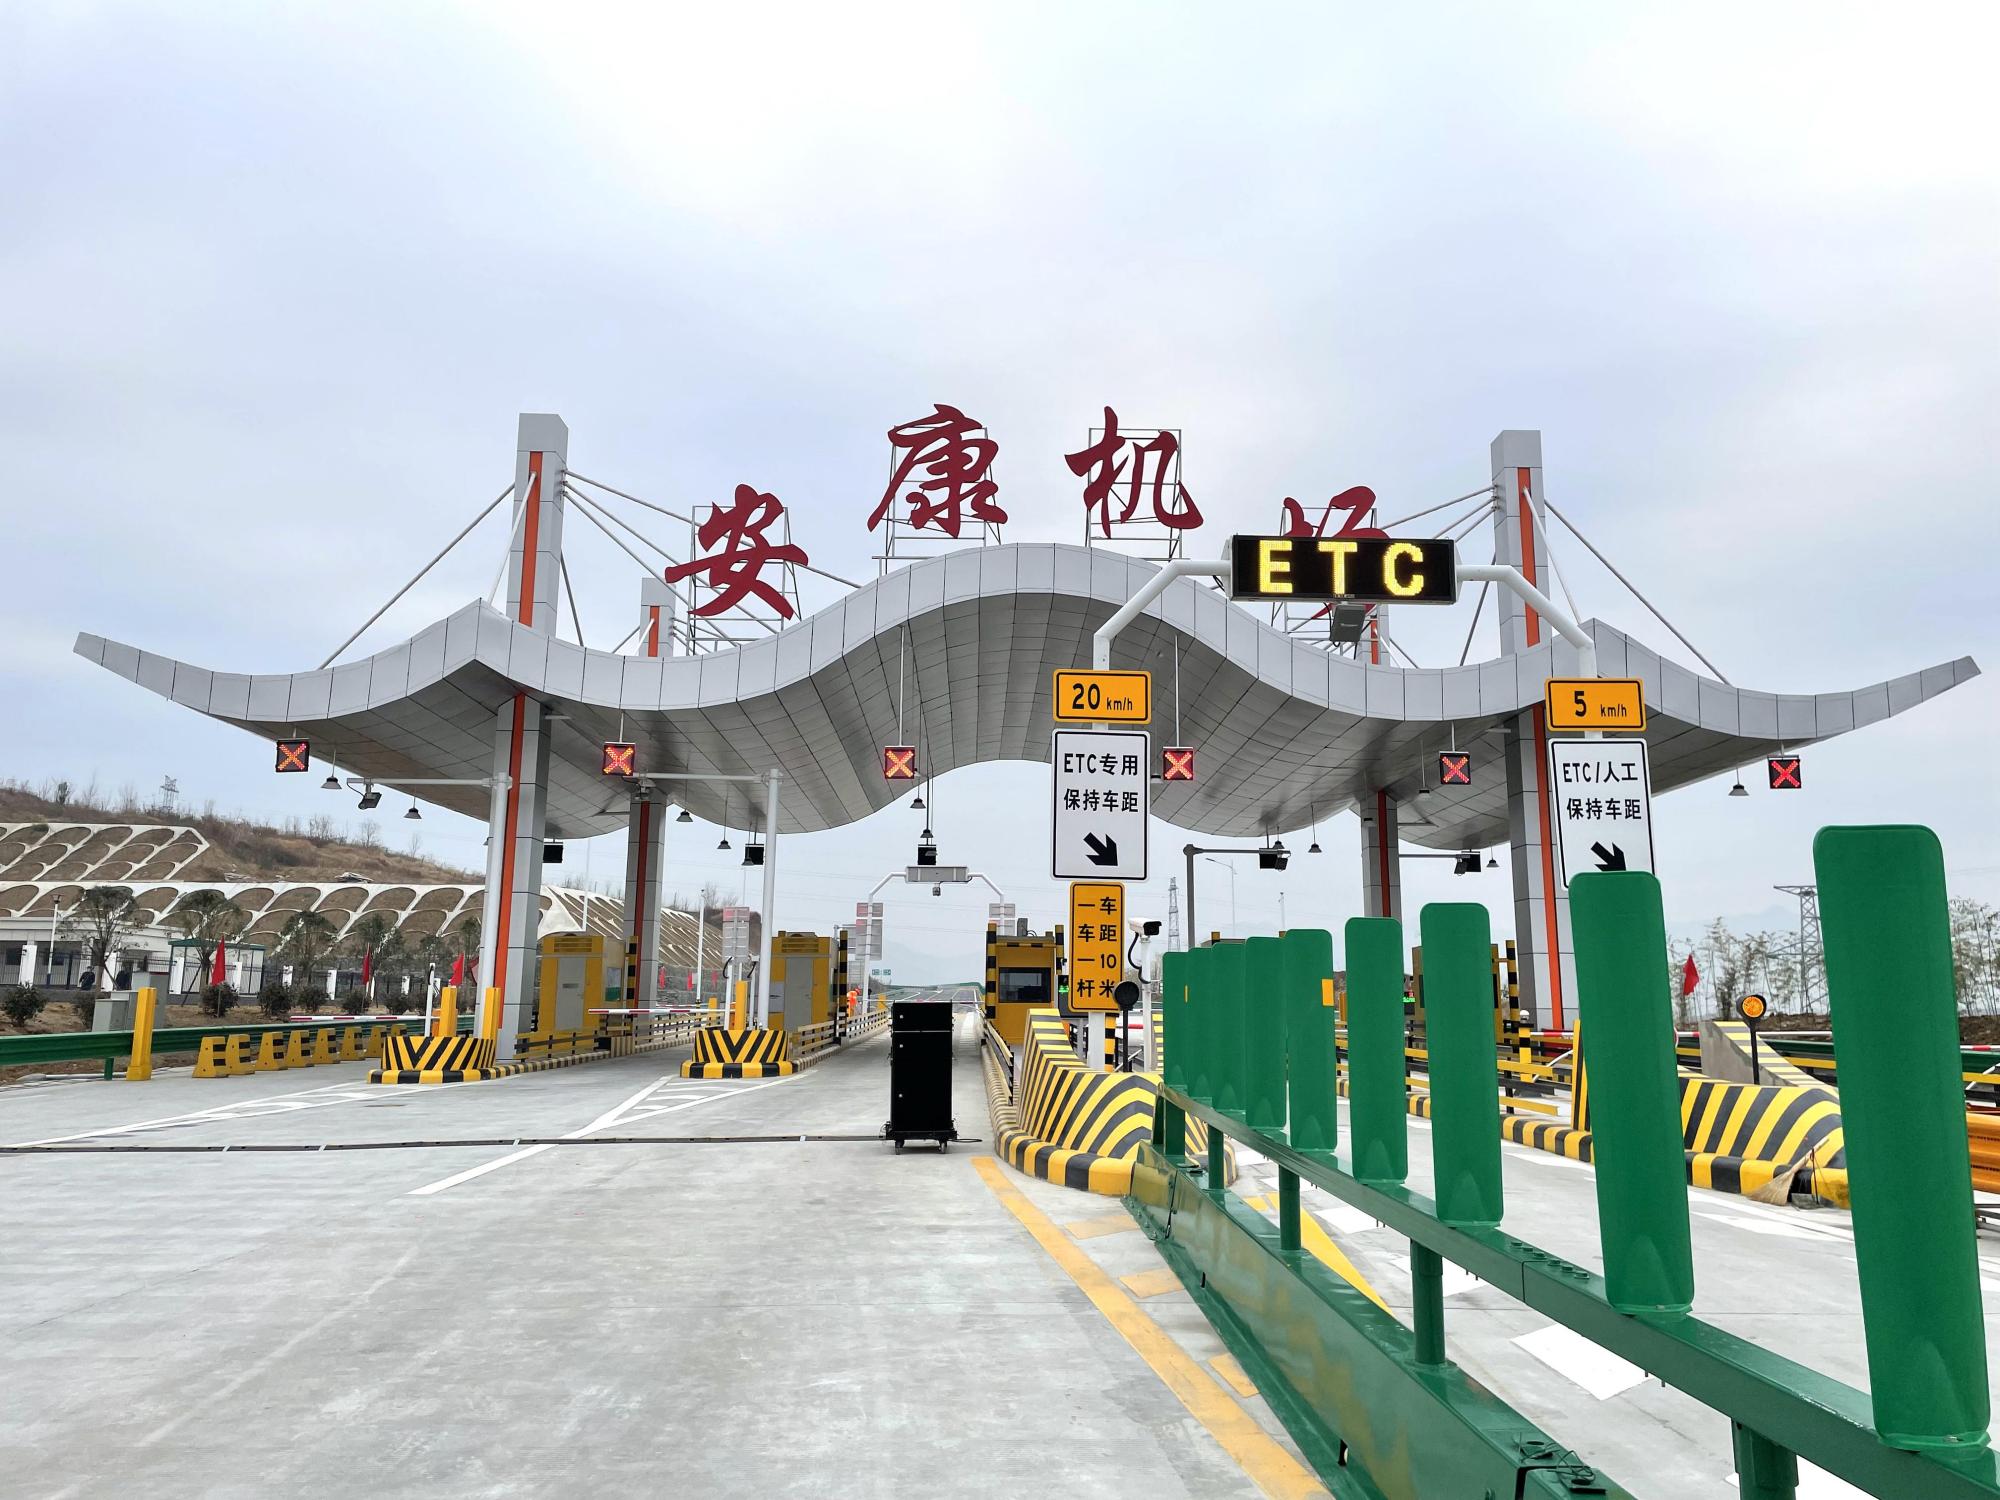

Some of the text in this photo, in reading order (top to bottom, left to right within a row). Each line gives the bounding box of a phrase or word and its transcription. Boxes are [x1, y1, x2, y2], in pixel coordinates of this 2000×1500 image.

[1258, 539, 1425, 597] ETC
[1072, 683, 1133, 711] 20 km/h
[1574, 690, 1627, 717] 5 km/h
[1063, 753, 1138, 776] ETC专用
[1562, 761, 1638, 783] ETC/人工
[1063, 788, 1139, 812] 保持车距
[1566, 798, 1642, 820] 保持车距
